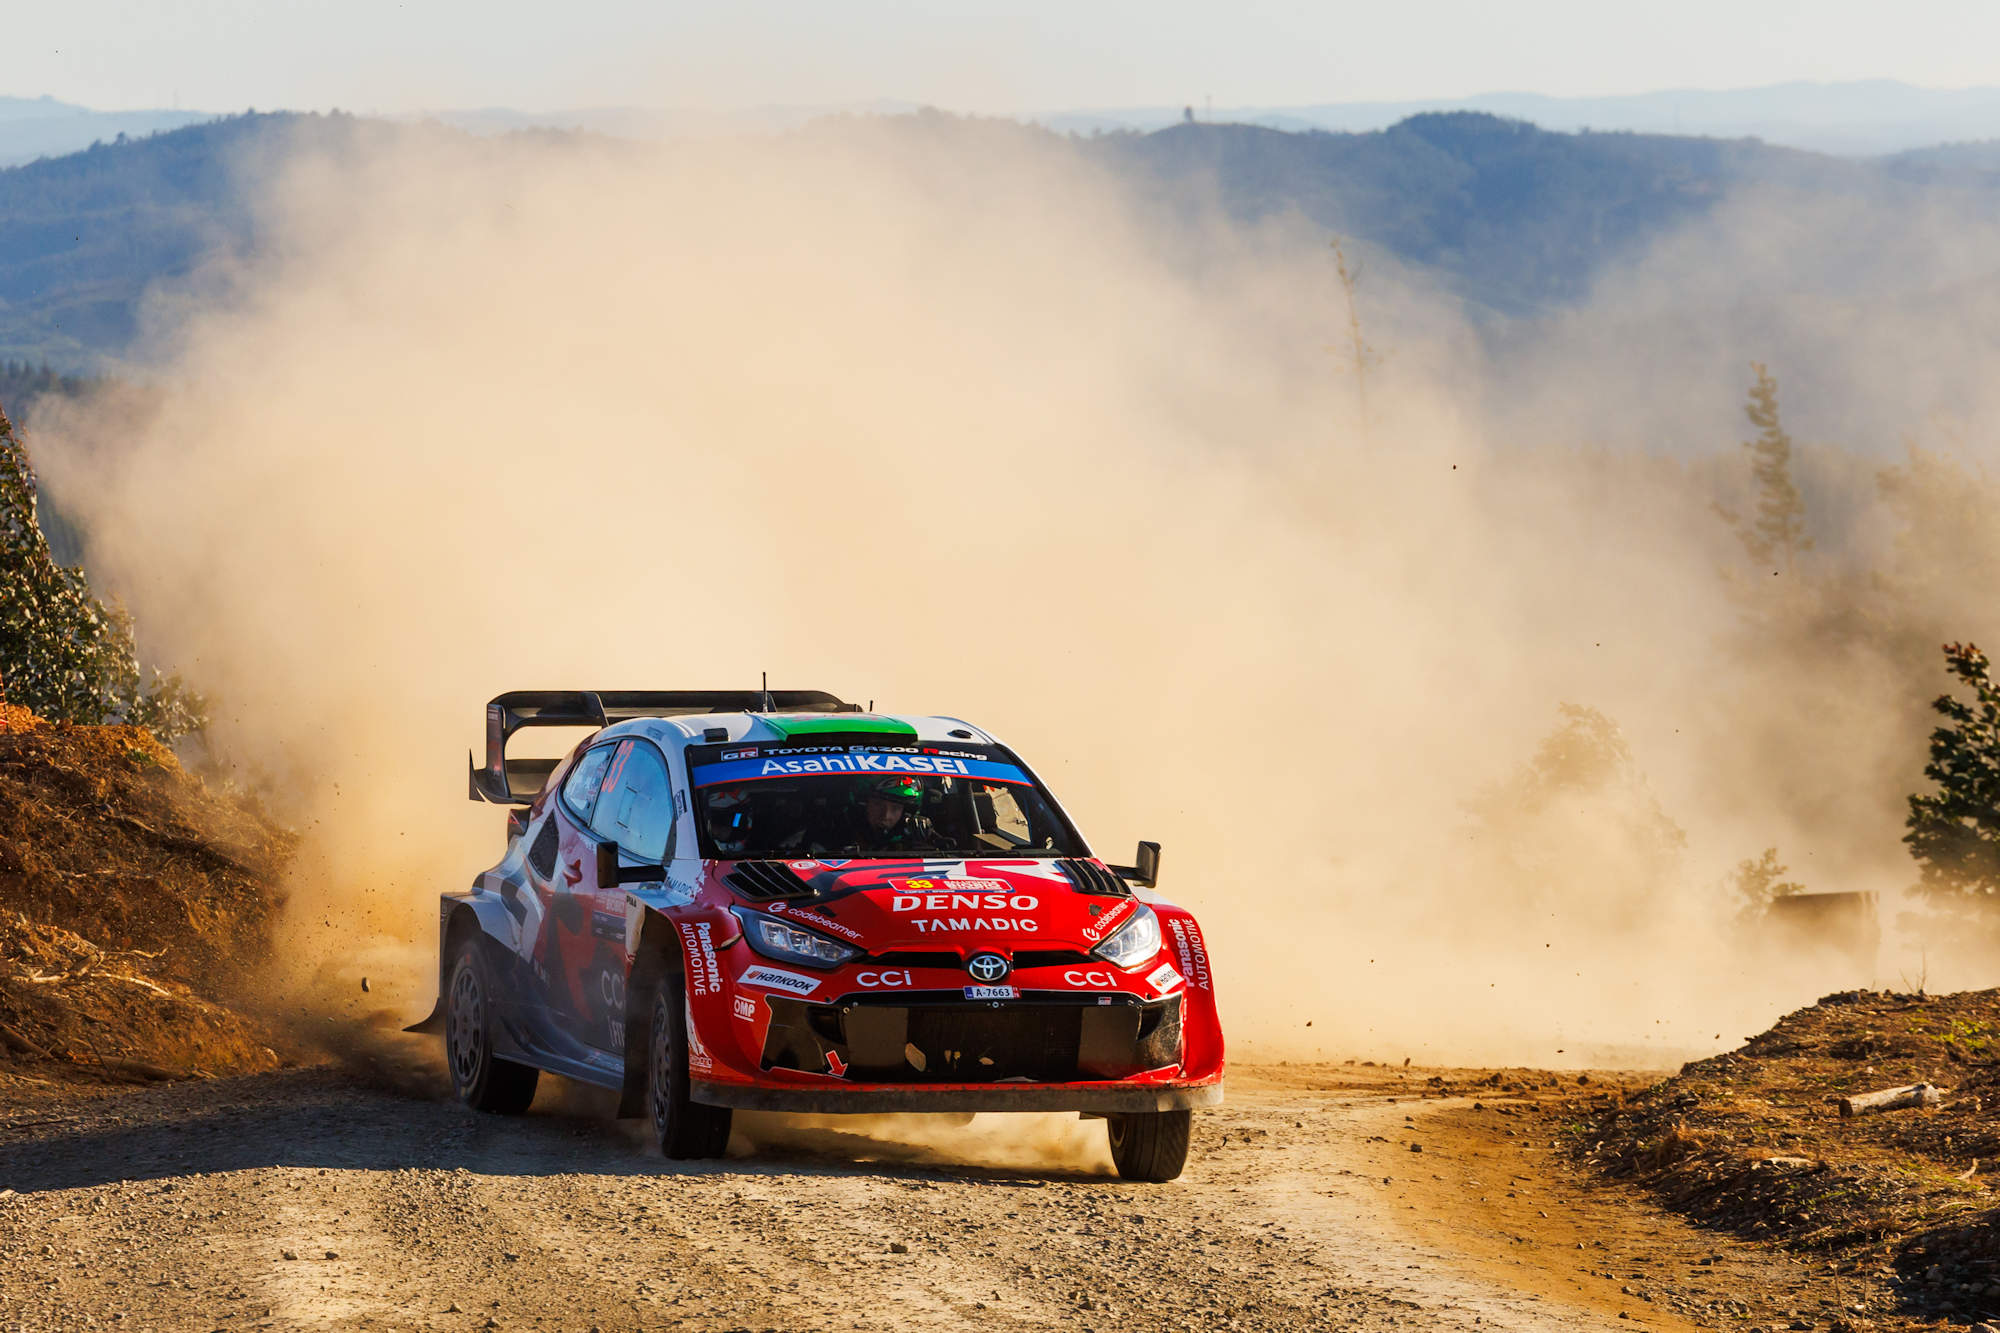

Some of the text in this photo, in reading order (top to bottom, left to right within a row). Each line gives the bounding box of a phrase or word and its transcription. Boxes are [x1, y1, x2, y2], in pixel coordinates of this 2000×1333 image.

[723, 750, 757, 759] GR
[764, 746, 844, 756] TOYOTA
[923, 748, 988, 760] Racing
[906, 880, 934, 889] 33
[892, 894, 1039, 912] DENSO
[787, 908, 862, 940] codebeamer
[911, 918, 1038, 933] TAMADIC
[1094, 901, 1129, 930] codebeamer
[680, 922, 707, 996] AUTOMOTIVE
[696, 922, 724, 993] Panasonic
[1168, 918, 1195, 988] Panasonic
[1182, 918, 1210, 990] AUTOMOTIVE
[976, 988, 1010, 997] A-7663
[733, 999, 755, 1018] OMP
